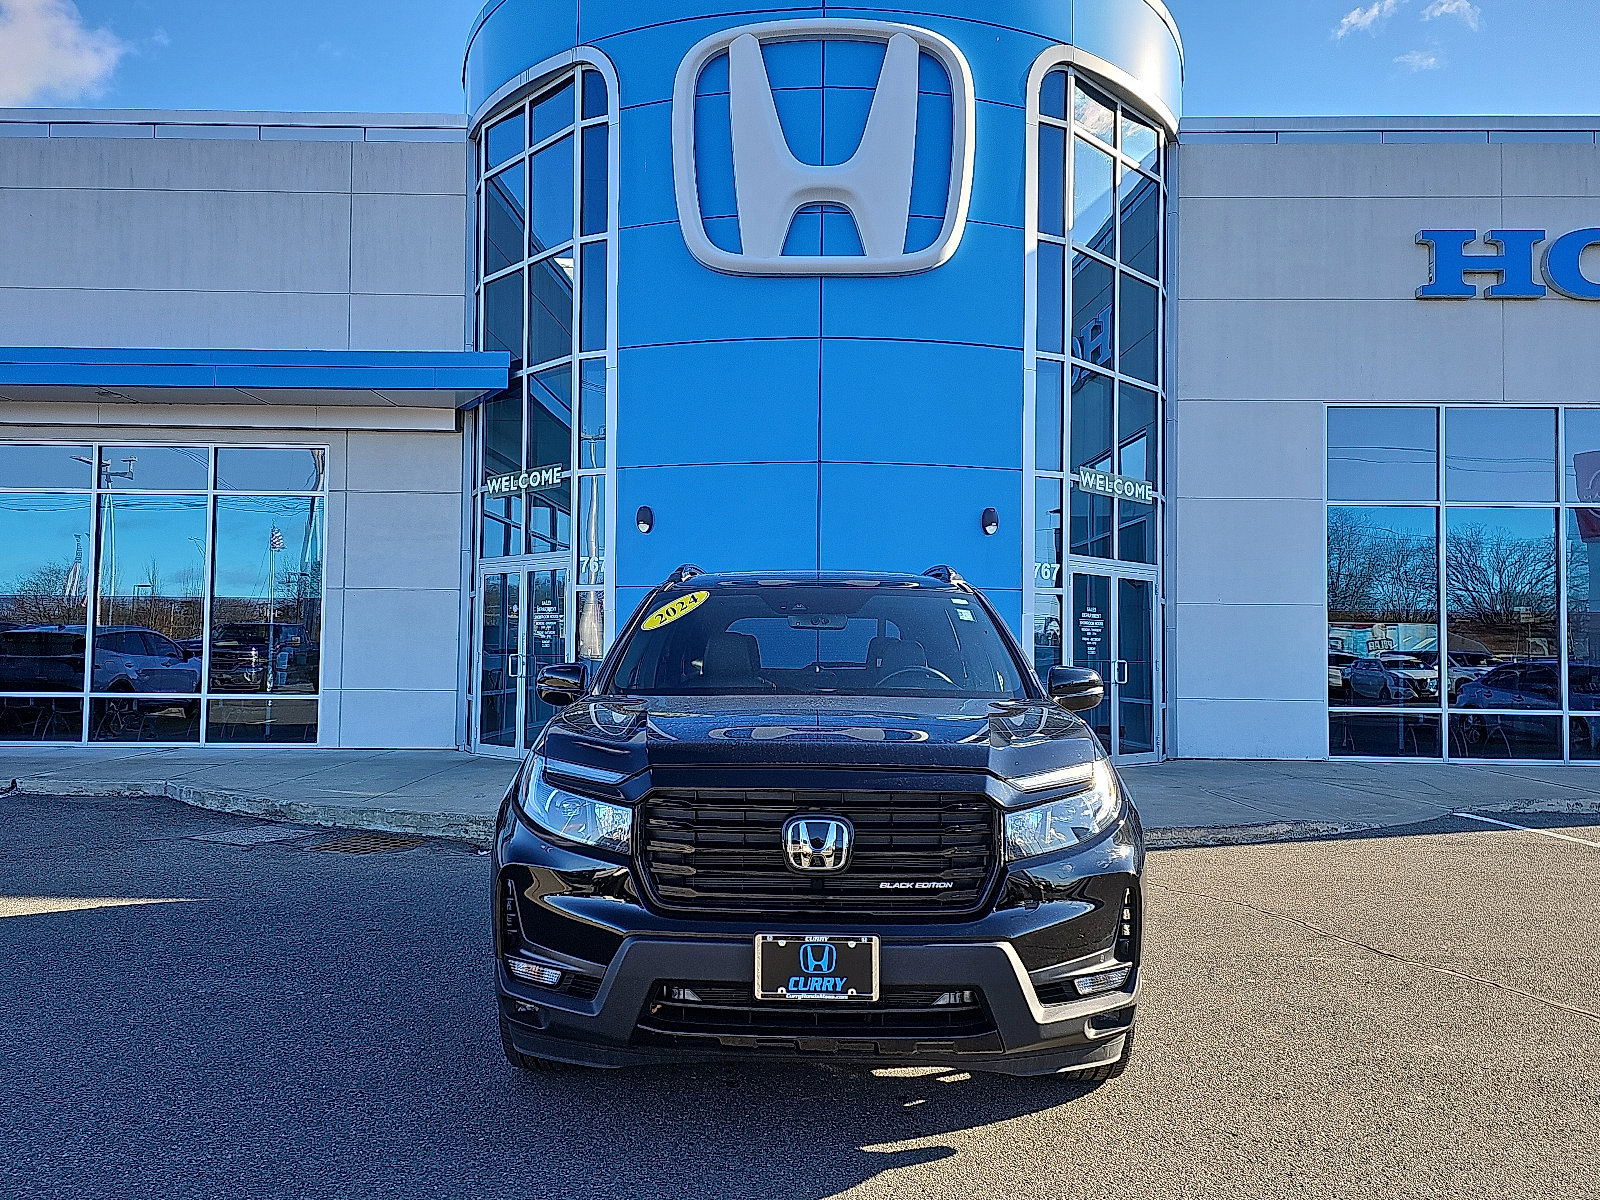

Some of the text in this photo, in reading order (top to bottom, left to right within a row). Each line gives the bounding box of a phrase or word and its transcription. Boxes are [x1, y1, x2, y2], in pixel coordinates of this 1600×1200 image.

[487, 467, 562, 494] WELCOME
[1080, 470, 1153, 501] WELCOME
[1034, 562, 1060, 580] 767
[654, 594, 699, 624] 2024
[915, 881, 954, 889] EDITION
[788, 976, 848, 992] CURRY
